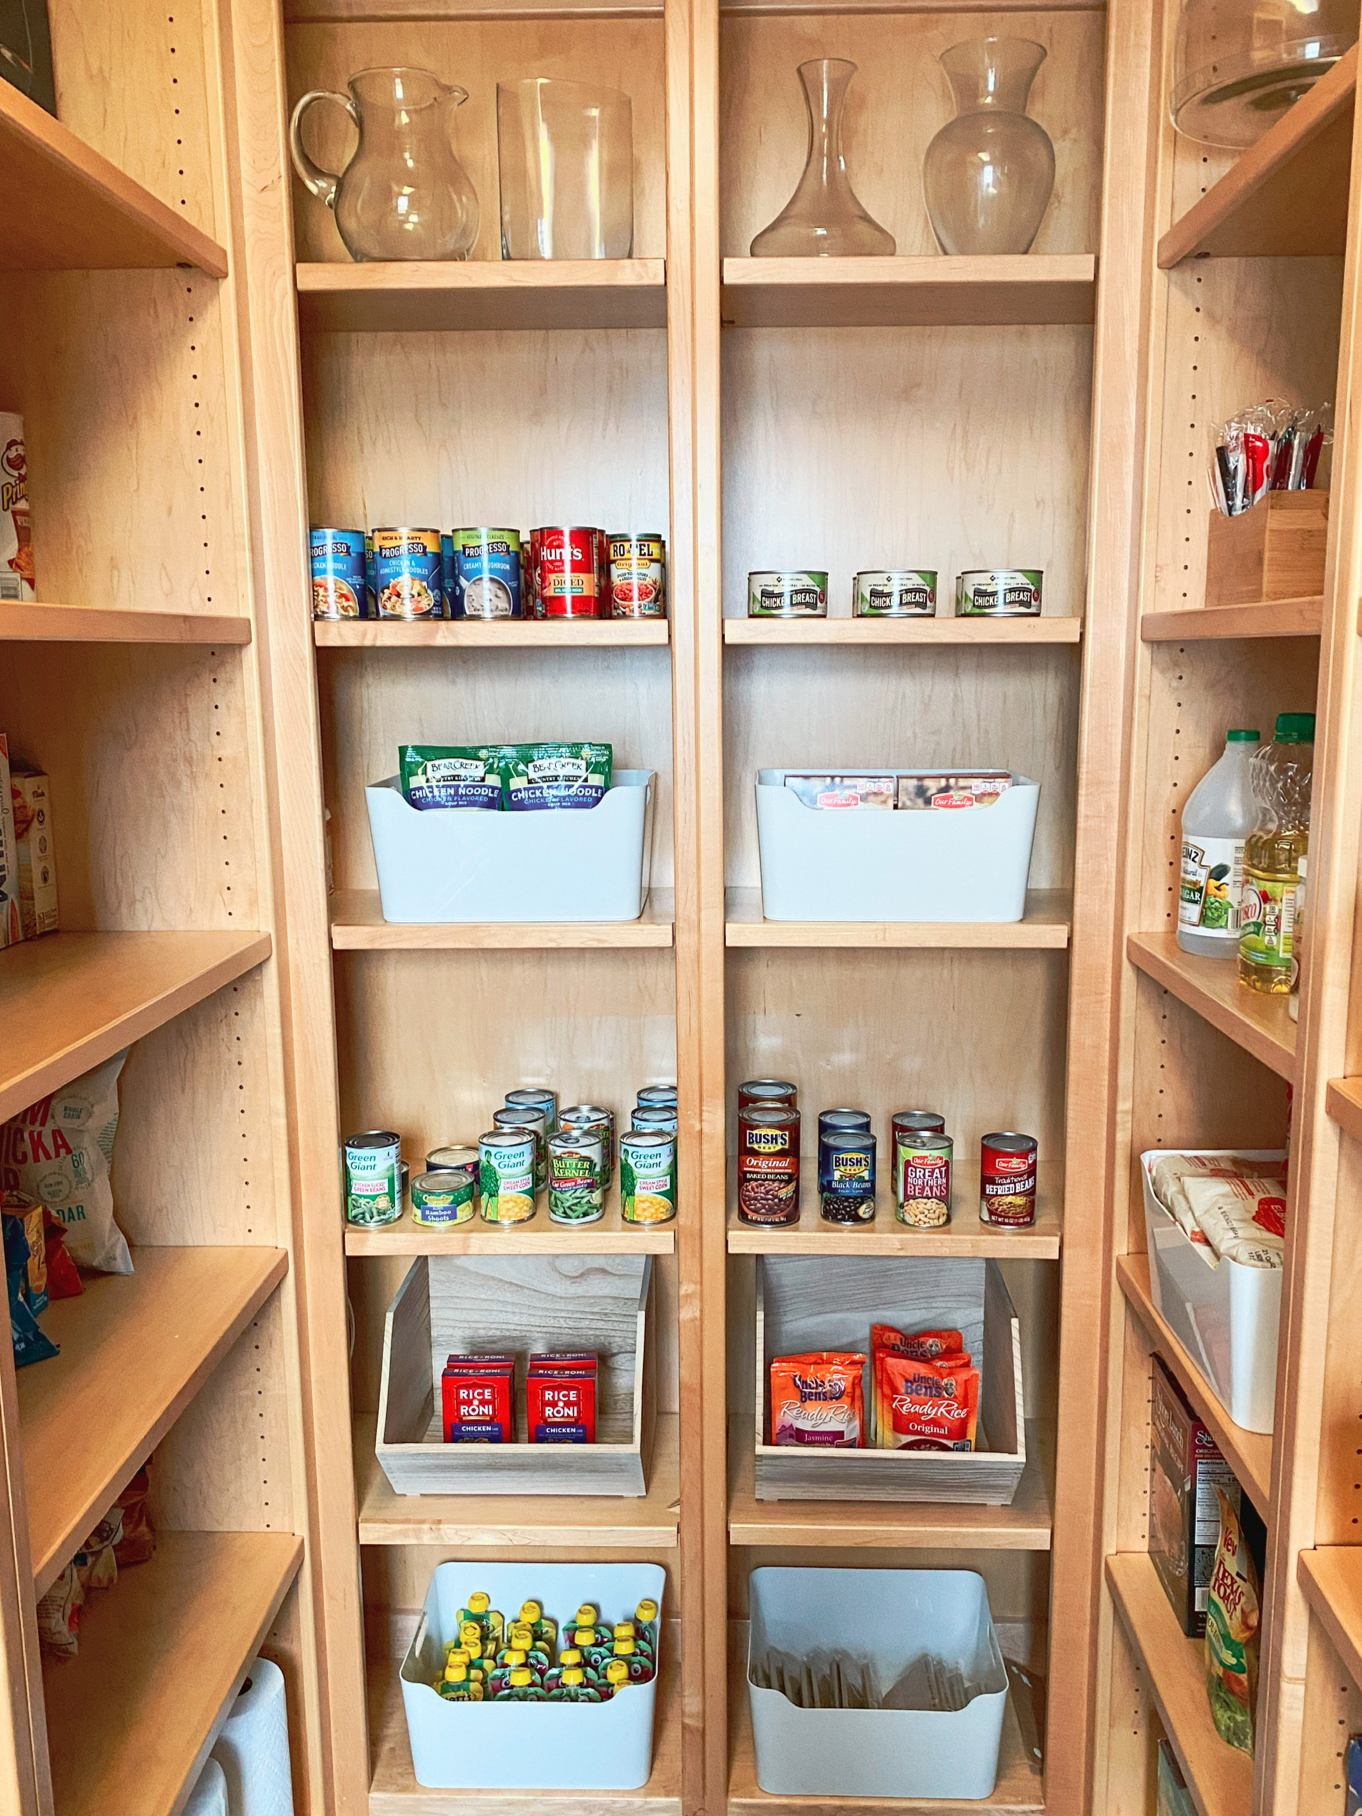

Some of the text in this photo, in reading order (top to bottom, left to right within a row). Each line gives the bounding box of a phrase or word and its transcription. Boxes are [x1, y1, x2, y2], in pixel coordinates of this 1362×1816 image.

[311, 543, 347, 558] ROGRSSO
[382, 543, 424, 558] PROGRESSO
[465, 542, 506, 556] PROGRESSO
[464, 562, 482, 570] CREAMY
[553, 578, 584, 587] DICED
[762, 592, 817, 608] CHICKEN BREAST
[902, 592, 927, 604] BREAST
[1005, 591, 1031, 603] BREAST
[410, 786, 500, 800] CHICKEN NOODLE
[935, 795, 972, 807] Our Family
[1182, 846, 1199, 863] EINZ
[748, 1132, 788, 1145] BUSH'S
[71, 1151, 84, 1169] 60
[348, 1151, 376, 1162] Green
[494, 1151, 525, 1160] Green
[631, 1151, 662, 1160] Green
[923, 1157, 942, 1165] Family
[350, 1161, 377, 1170] Giant
[498, 1160, 525, 1169] Giant
[553, 1159, 590, 1168] BUTTER
[635, 1160, 662, 1169] Giant
[746, 1157, 790, 1168] Original
[835, 1156, 870, 1168] BUSH'S
[554, 1168, 590, 1177] KERNEL
[908, 1167, 946, 1178] GREAT
[908, 1177, 946, 1185] NORTHERN
[986, 1176, 1035, 1194] REFRIED BEANS
[995, 1174, 1028, 1184] Traditional
[908, 1185, 946, 1197] BEANS
[900, 1338, 925, 1350] Uncle
[913, 1373, 941, 1386] Uncle
[460, 1389, 492, 1399] RICE
[545, 1391, 577, 1401] RICE
[460, 1406, 492, 1416] RONI
[545, 1407, 578, 1417] RONI
[780, 1400, 828, 1428] Ready
[892, 1394, 969, 1424] Ready Rice
[909, 1422, 948, 1435] Original
[804, 1433, 833, 1441] Jasmine
[1217, 1558, 1245, 1606] TEXAS
[1212, 1576, 1237, 1620] TOAST
